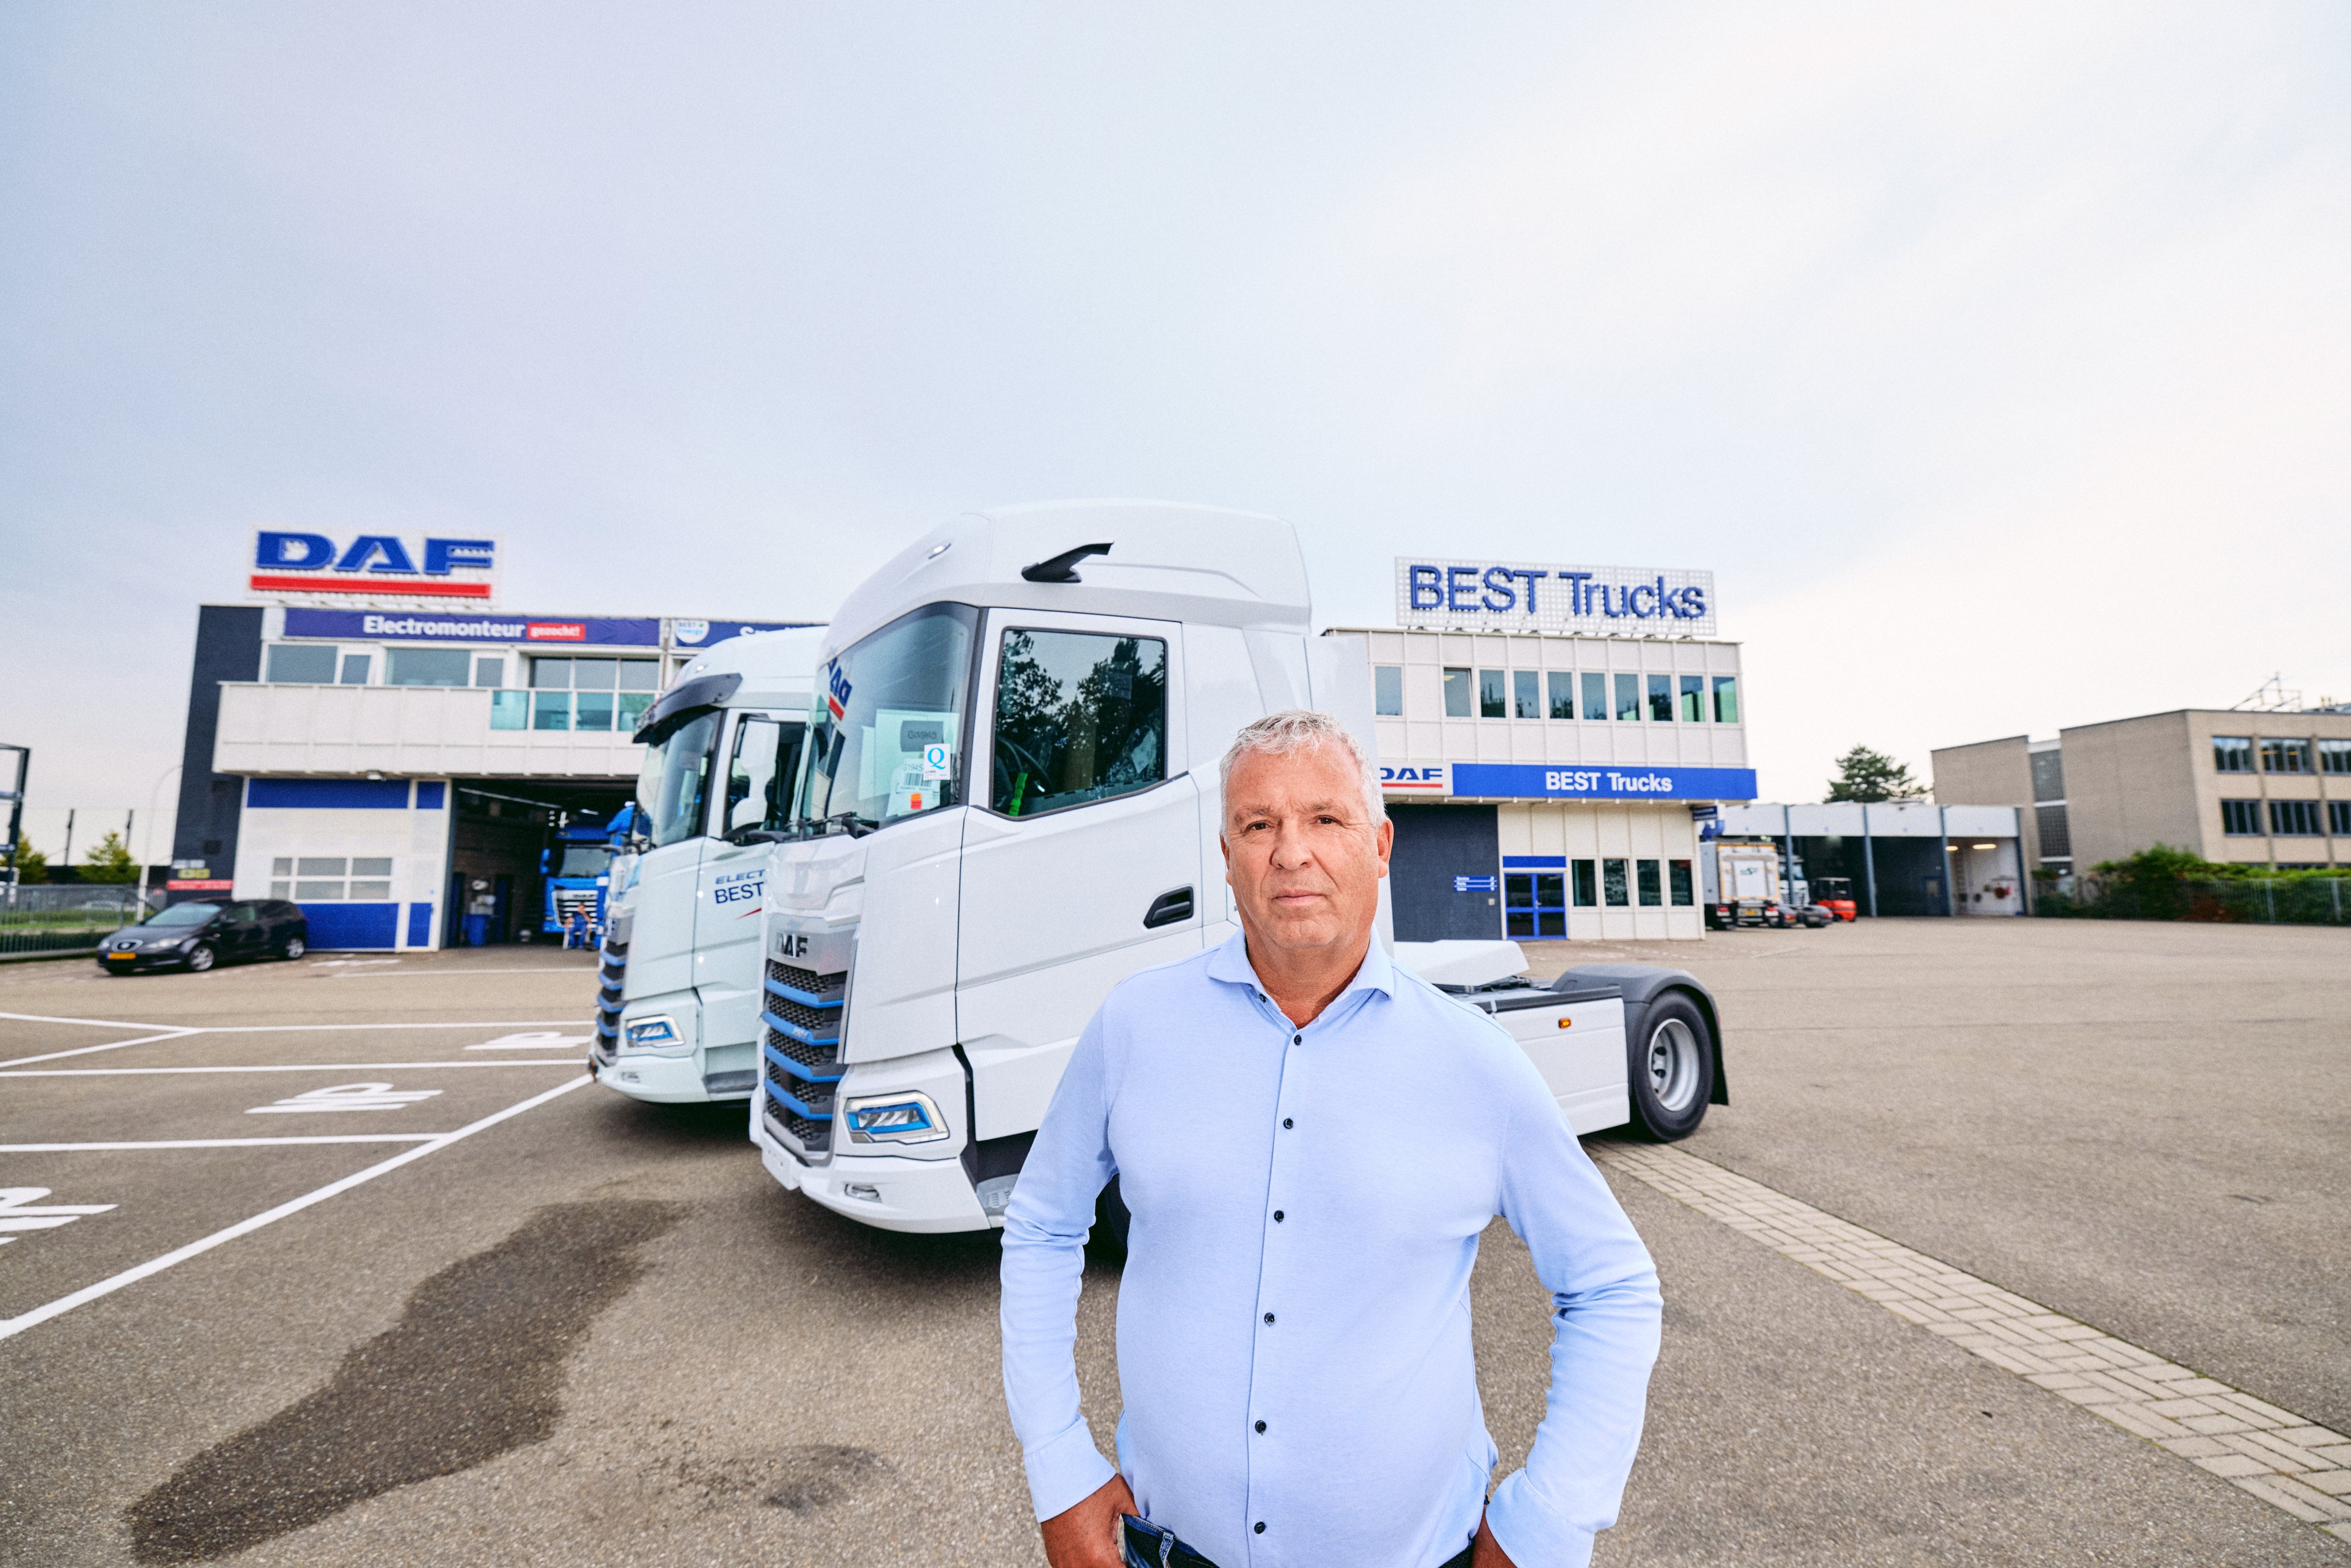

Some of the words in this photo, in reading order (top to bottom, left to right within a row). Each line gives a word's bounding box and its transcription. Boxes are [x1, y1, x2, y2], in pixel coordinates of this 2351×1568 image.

[255, 530, 495, 575] DAF
[1410, 565, 1547, 614] BEST
[1559, 572, 1706, 619] Trucks
[363, 615, 526, 638] Electromonteur
[928, 748, 946, 770] Q
[1380, 767, 1442, 780] DAF
[1545, 771, 1601, 791] BEST
[1607, 772, 1673, 792] Trucks
[715, 882, 764, 904] BEST
